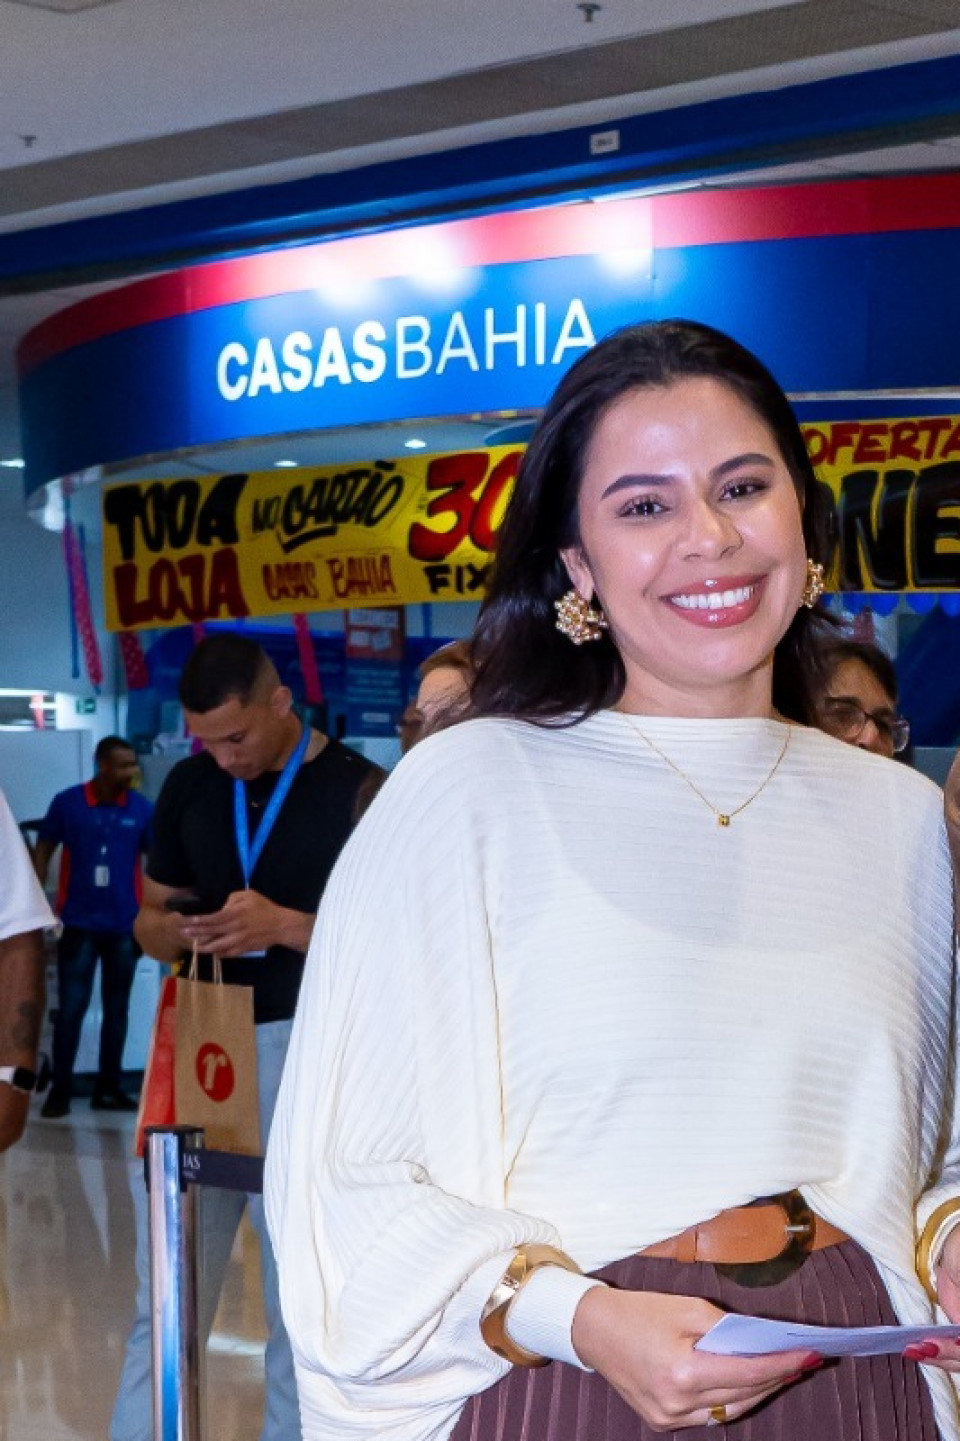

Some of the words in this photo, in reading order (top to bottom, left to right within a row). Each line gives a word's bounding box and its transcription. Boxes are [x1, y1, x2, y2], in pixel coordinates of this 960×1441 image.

[217, 320, 387, 401] CASAS
[396, 298, 597, 379] BAHIA
[105, 474, 248, 561] TODA
[281, 460, 404, 534] CARTÃO
[114, 547, 249, 627] LOJA
[326, 554, 396, 598] BAHIA
